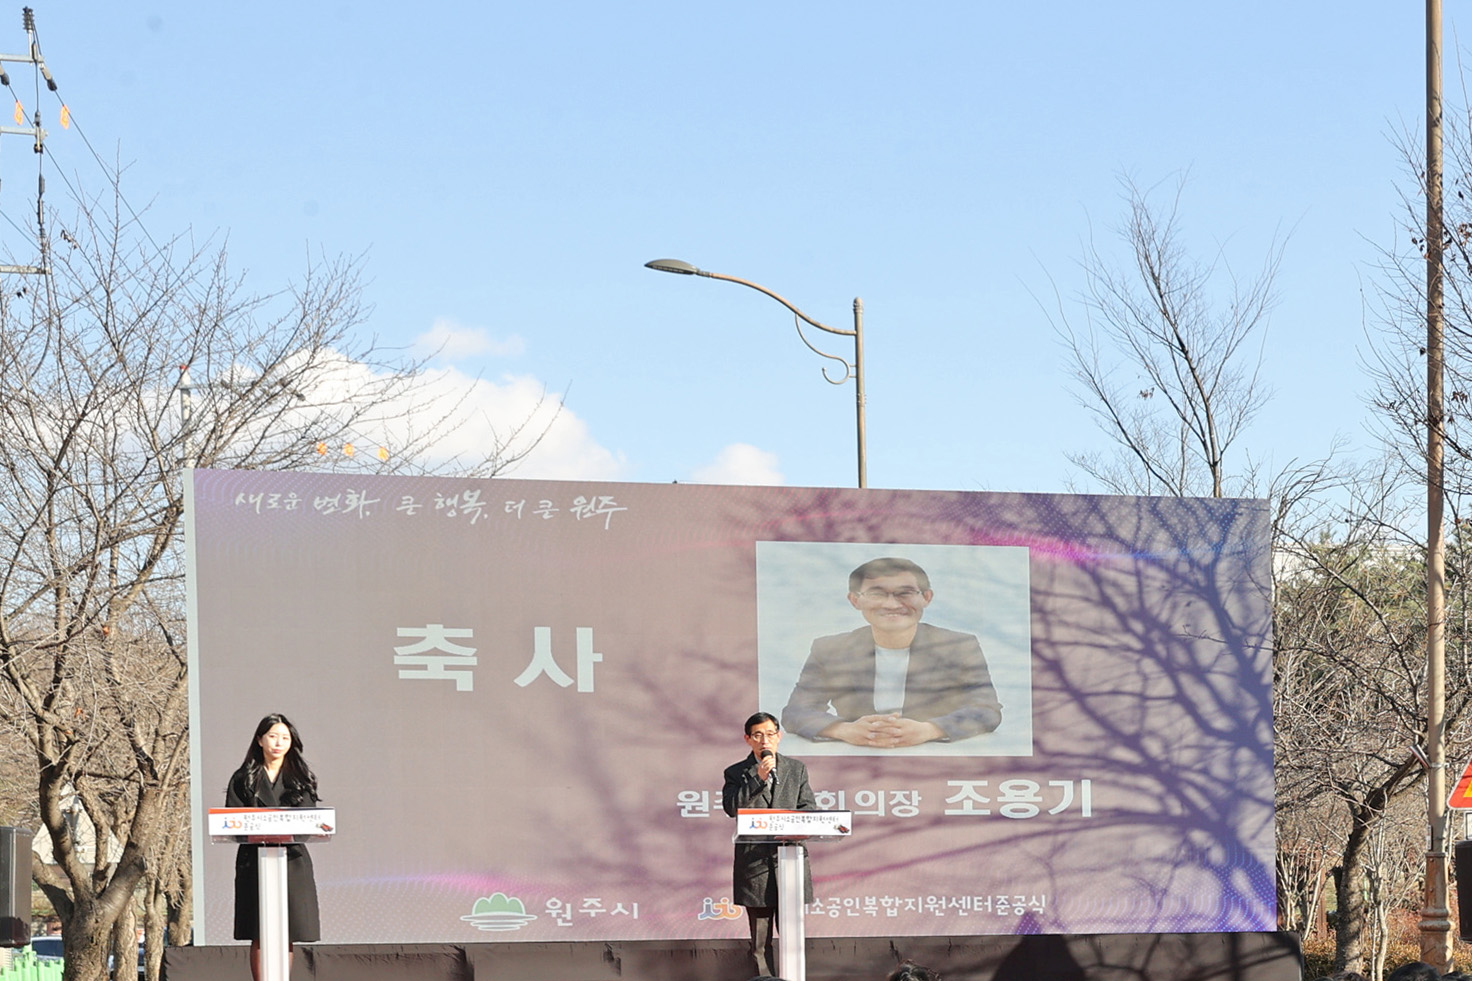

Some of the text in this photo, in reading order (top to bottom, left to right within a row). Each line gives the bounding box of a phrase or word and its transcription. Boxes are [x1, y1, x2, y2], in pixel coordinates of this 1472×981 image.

[235, 493, 302, 514] 새로운
[396, 495, 422, 515] 큰
[504, 499, 523, 519] 더
[532, 498, 559, 515] 큰
[569, 495, 628, 530] 원주
[944, 778, 1092, 820] 조용기
[545, 897, 640, 927] 원주시
